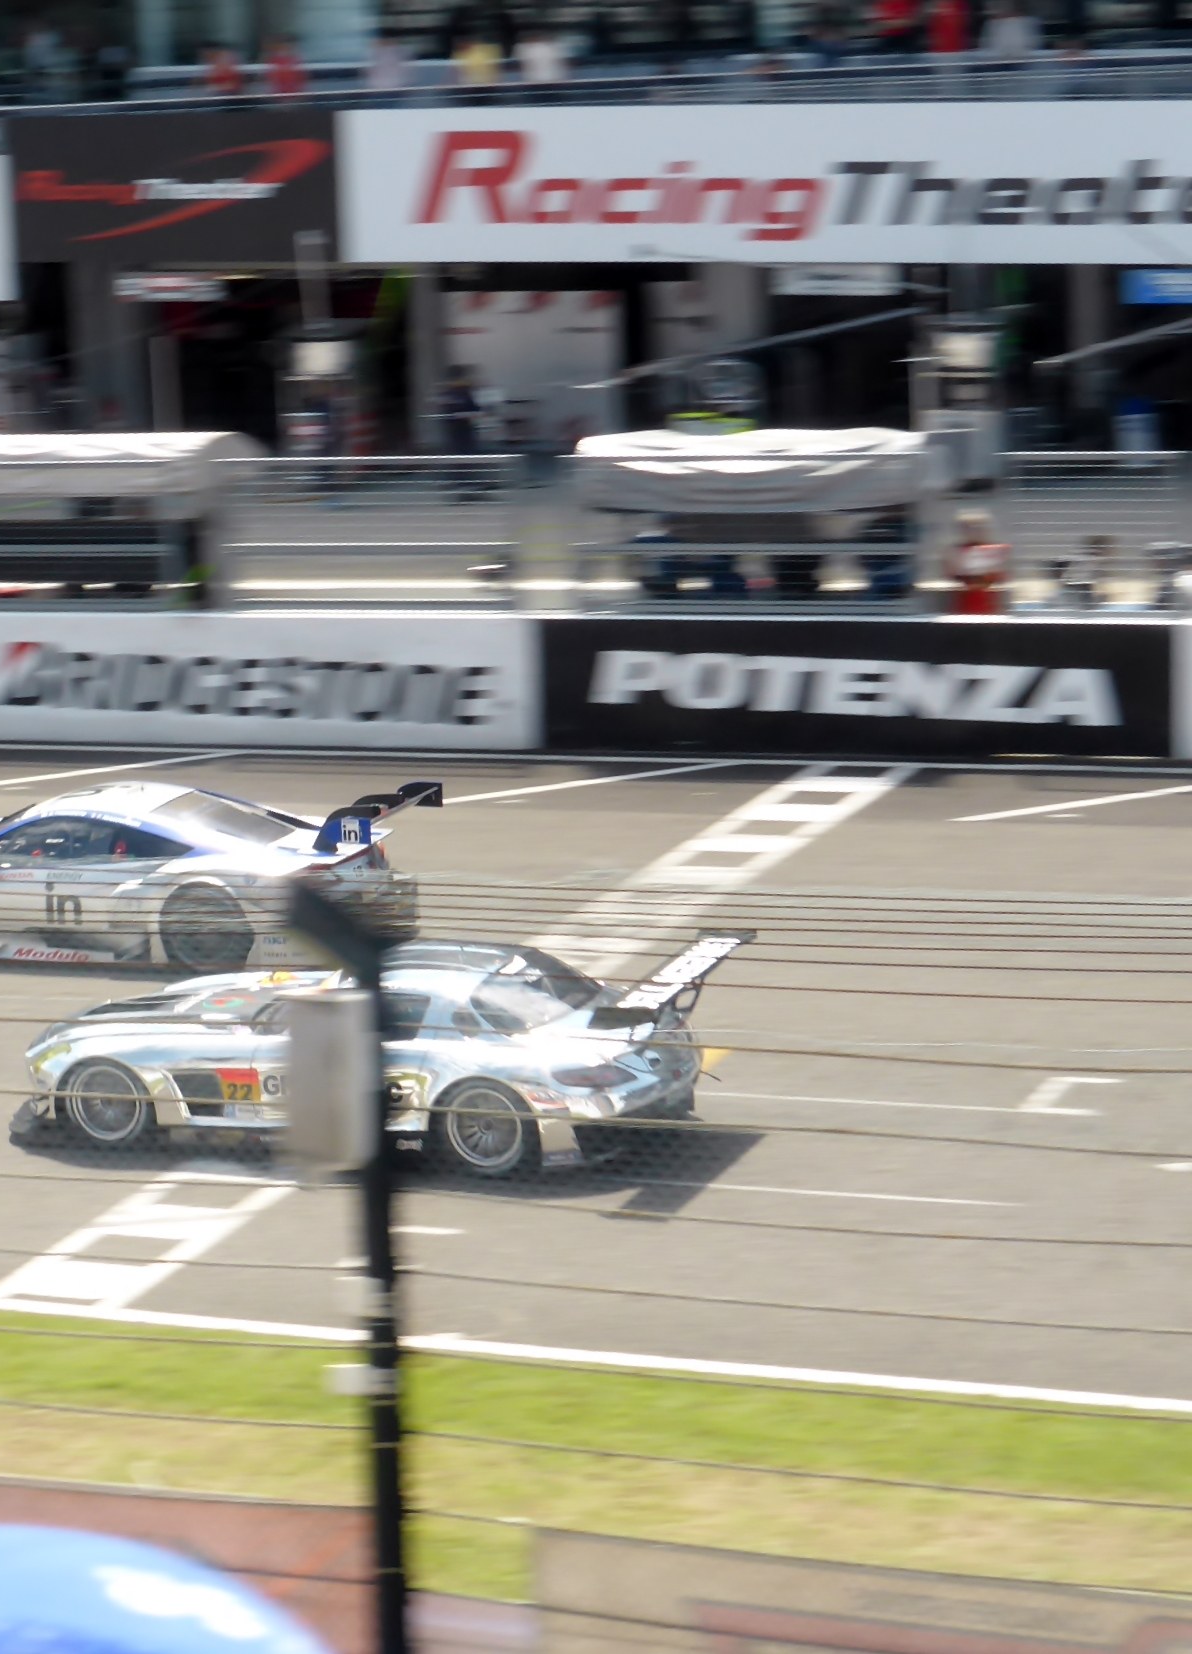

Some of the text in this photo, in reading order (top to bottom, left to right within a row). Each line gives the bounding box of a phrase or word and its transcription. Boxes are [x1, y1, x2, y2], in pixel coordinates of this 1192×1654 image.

[416, 130, 828, 241] Racing
[588, 650, 1124, 727] POTENZA
[45, 881, 82, 925] in
[13, 947, 90, 962] Modulo
[226, 1083, 253, 1101] 22
